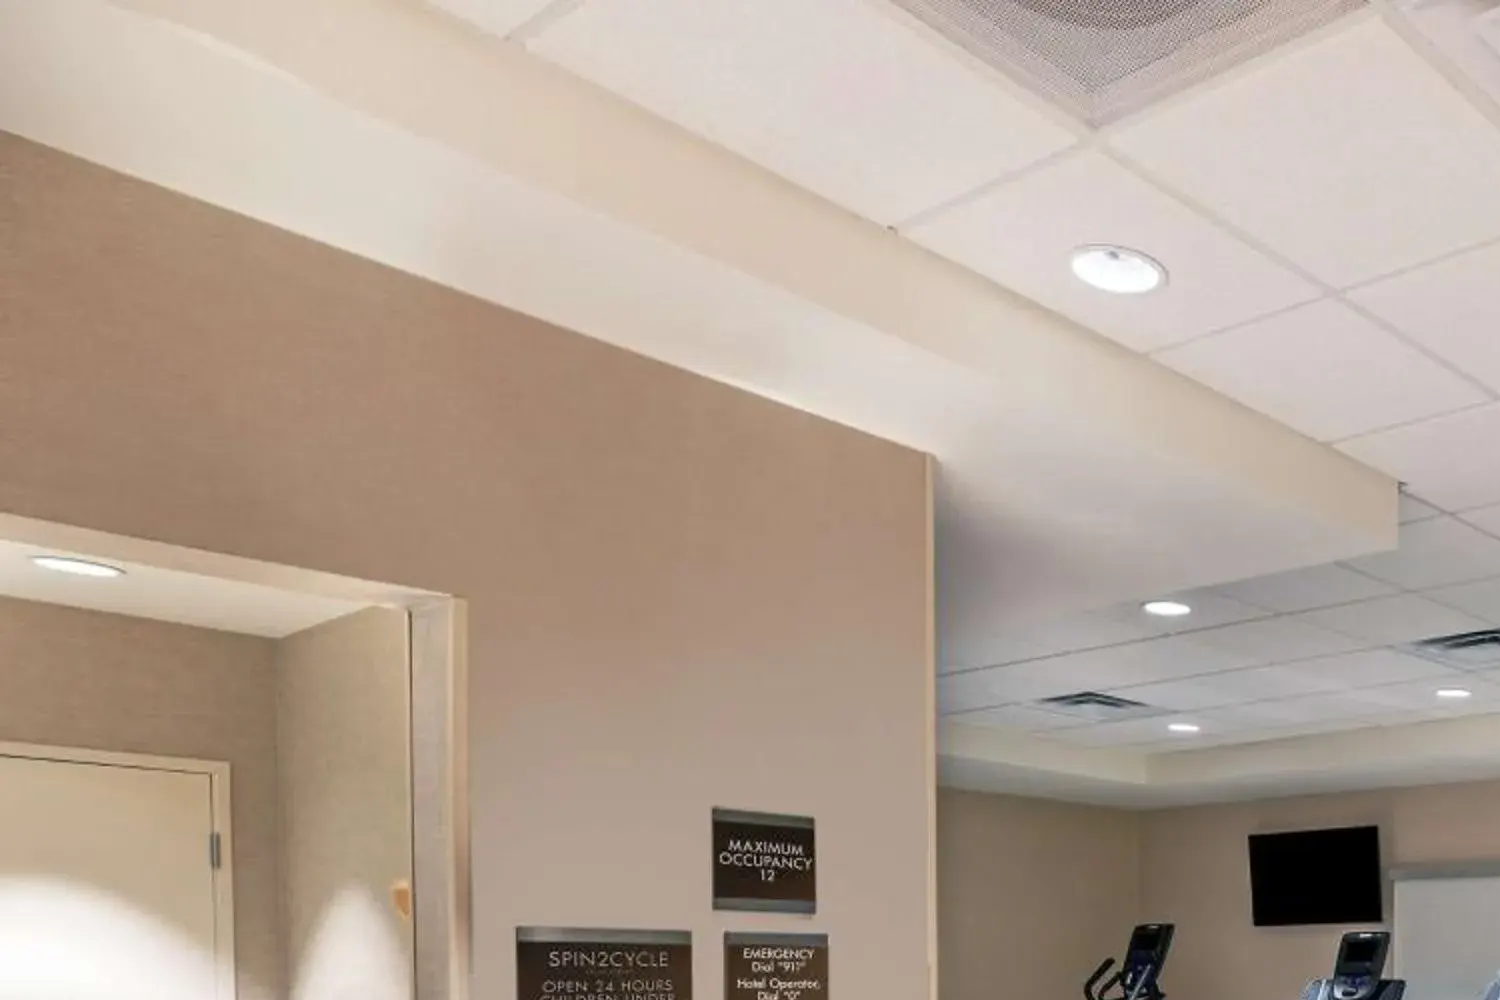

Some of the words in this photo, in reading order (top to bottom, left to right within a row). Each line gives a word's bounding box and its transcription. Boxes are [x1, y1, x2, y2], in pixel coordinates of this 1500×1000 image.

[728, 839, 804, 856] MAXIMUM
[719, 851, 812, 871] OCCUPANCY
[761, 868, 775, 881] 12
[548, 951, 670, 968] SPIN2CYCLE
[743, 947, 815, 959] EMERGENCY
[751, 961, 774, 972] Dial
[541, 979, 588, 993] OPEN
[595, 980, 614, 992] 24
[621, 979, 673, 992] HOURS
[737, 977, 766, 989] Hotel
